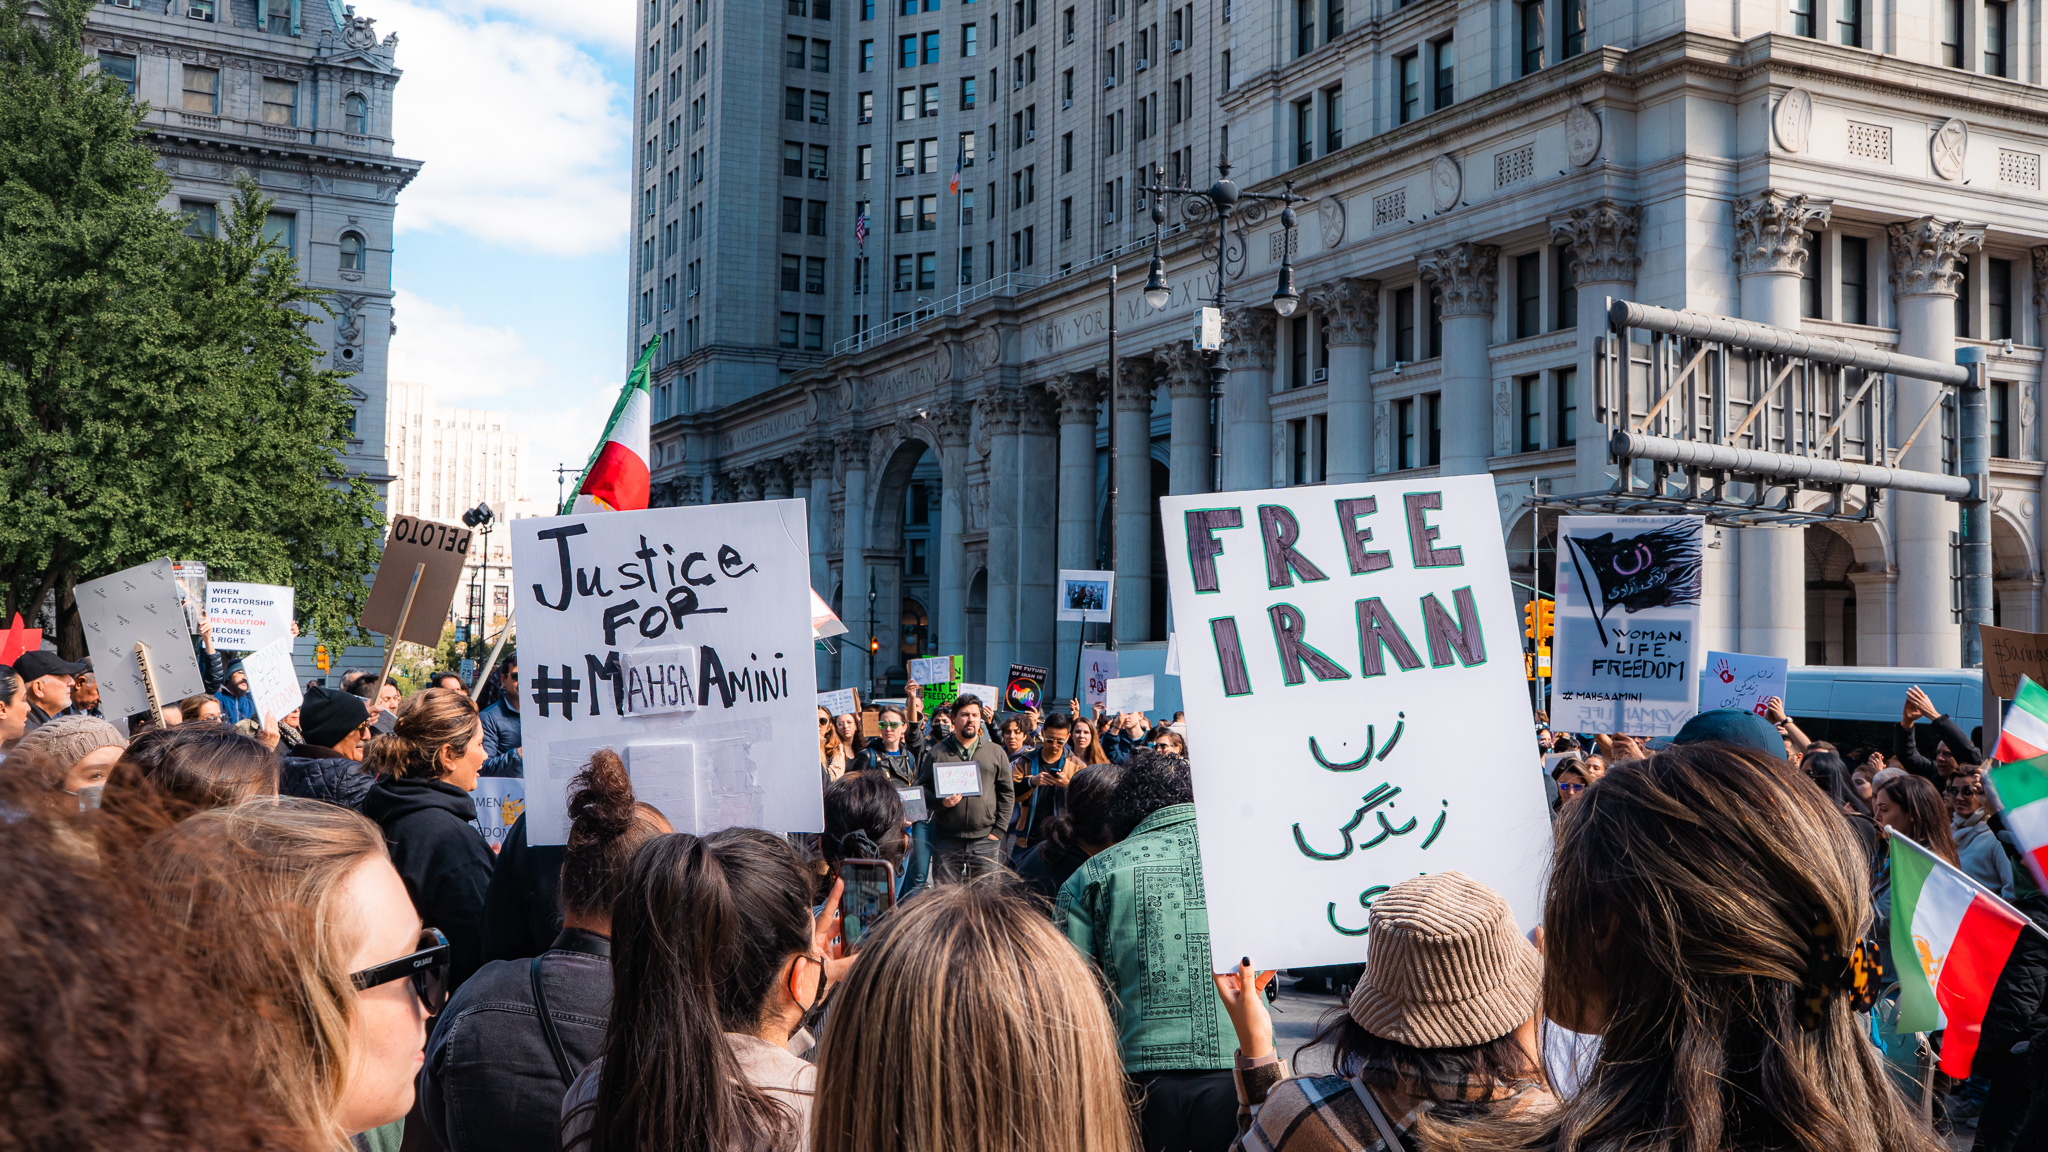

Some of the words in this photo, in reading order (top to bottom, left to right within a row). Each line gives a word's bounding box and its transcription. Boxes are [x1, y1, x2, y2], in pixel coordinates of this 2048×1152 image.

[1074, 309, 1107, 340] YOR
[736, 418, 781, 447] AMSTERDAM
[395, 518, 472, 555] PELOTO
[1184, 490, 1466, 595] FREE
[531, 523, 759, 612] Justice
[1613, 542, 1652, 576] زن
[211, 597, 274, 606] DICTATORSHIP
[231, 608, 254, 617] FACT,
[602, 585, 728, 646] FOR
[210, 617, 266, 626] REVOLUTION
[217, 637, 246, 645] RIGHT.
[1207, 584, 1489, 698] IRAN
[1023, 666, 1047, 674] FUTURE
[1592, 659, 1685, 682] FREEDOM
[1758, 667, 1774, 678] زن
[1308, 711, 1406, 773] زن
[1292, 782, 1449, 862] زندگی
[413, 956, 433, 968] QUAY
